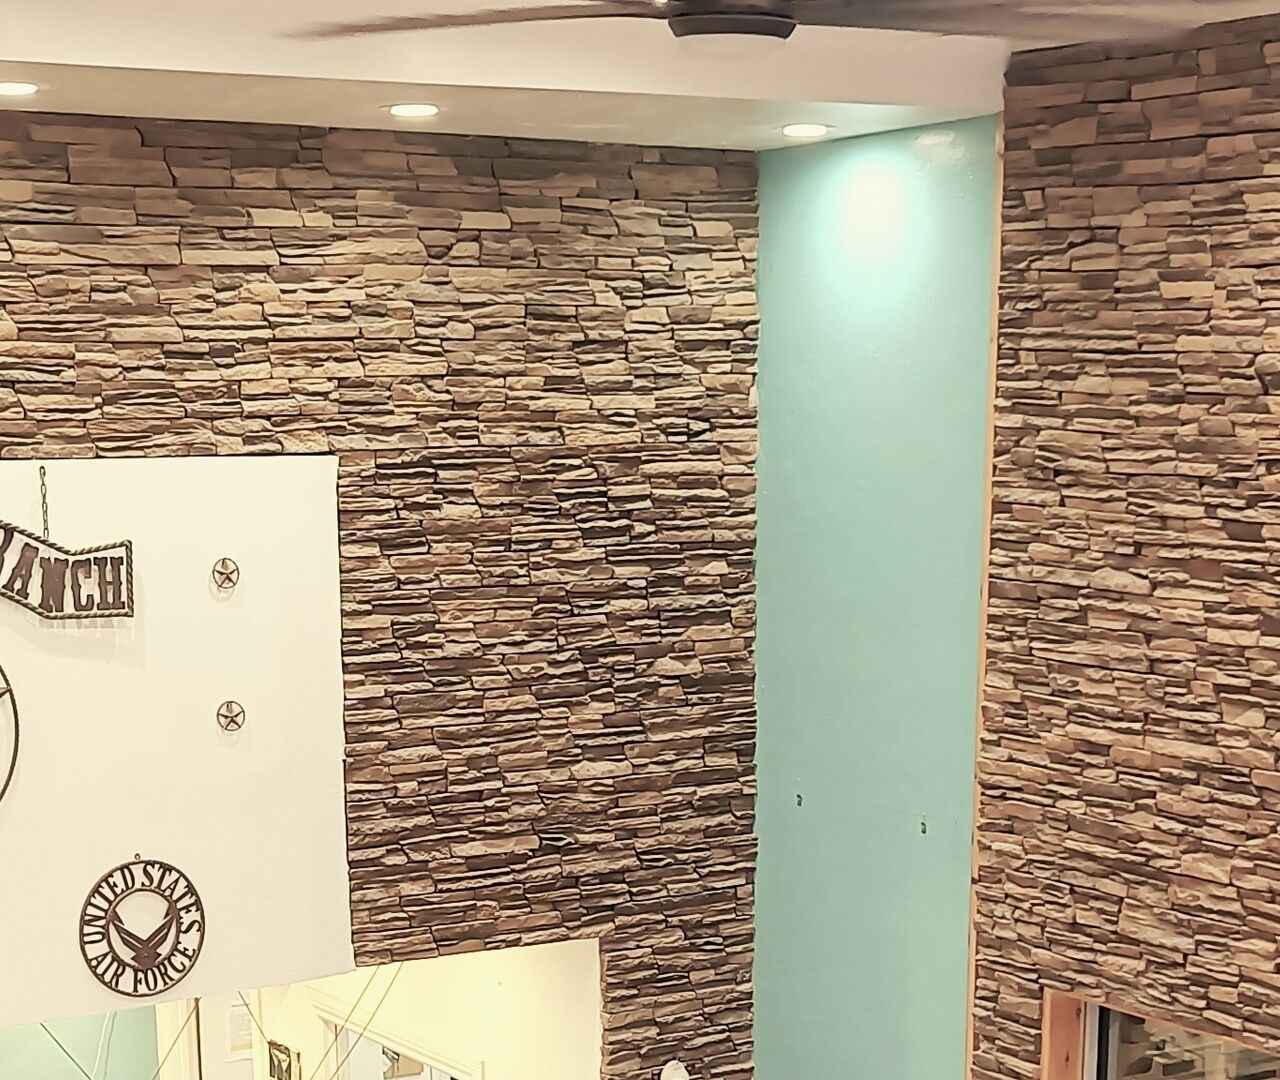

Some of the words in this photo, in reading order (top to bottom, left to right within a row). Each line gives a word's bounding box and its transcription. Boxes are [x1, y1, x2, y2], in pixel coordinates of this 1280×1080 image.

[83, 865, 135, 945] UNITED
[141, 863, 202, 935] STATES
[88, 951, 127, 989] AIR
[131, 940, 197, 993] FORCE
